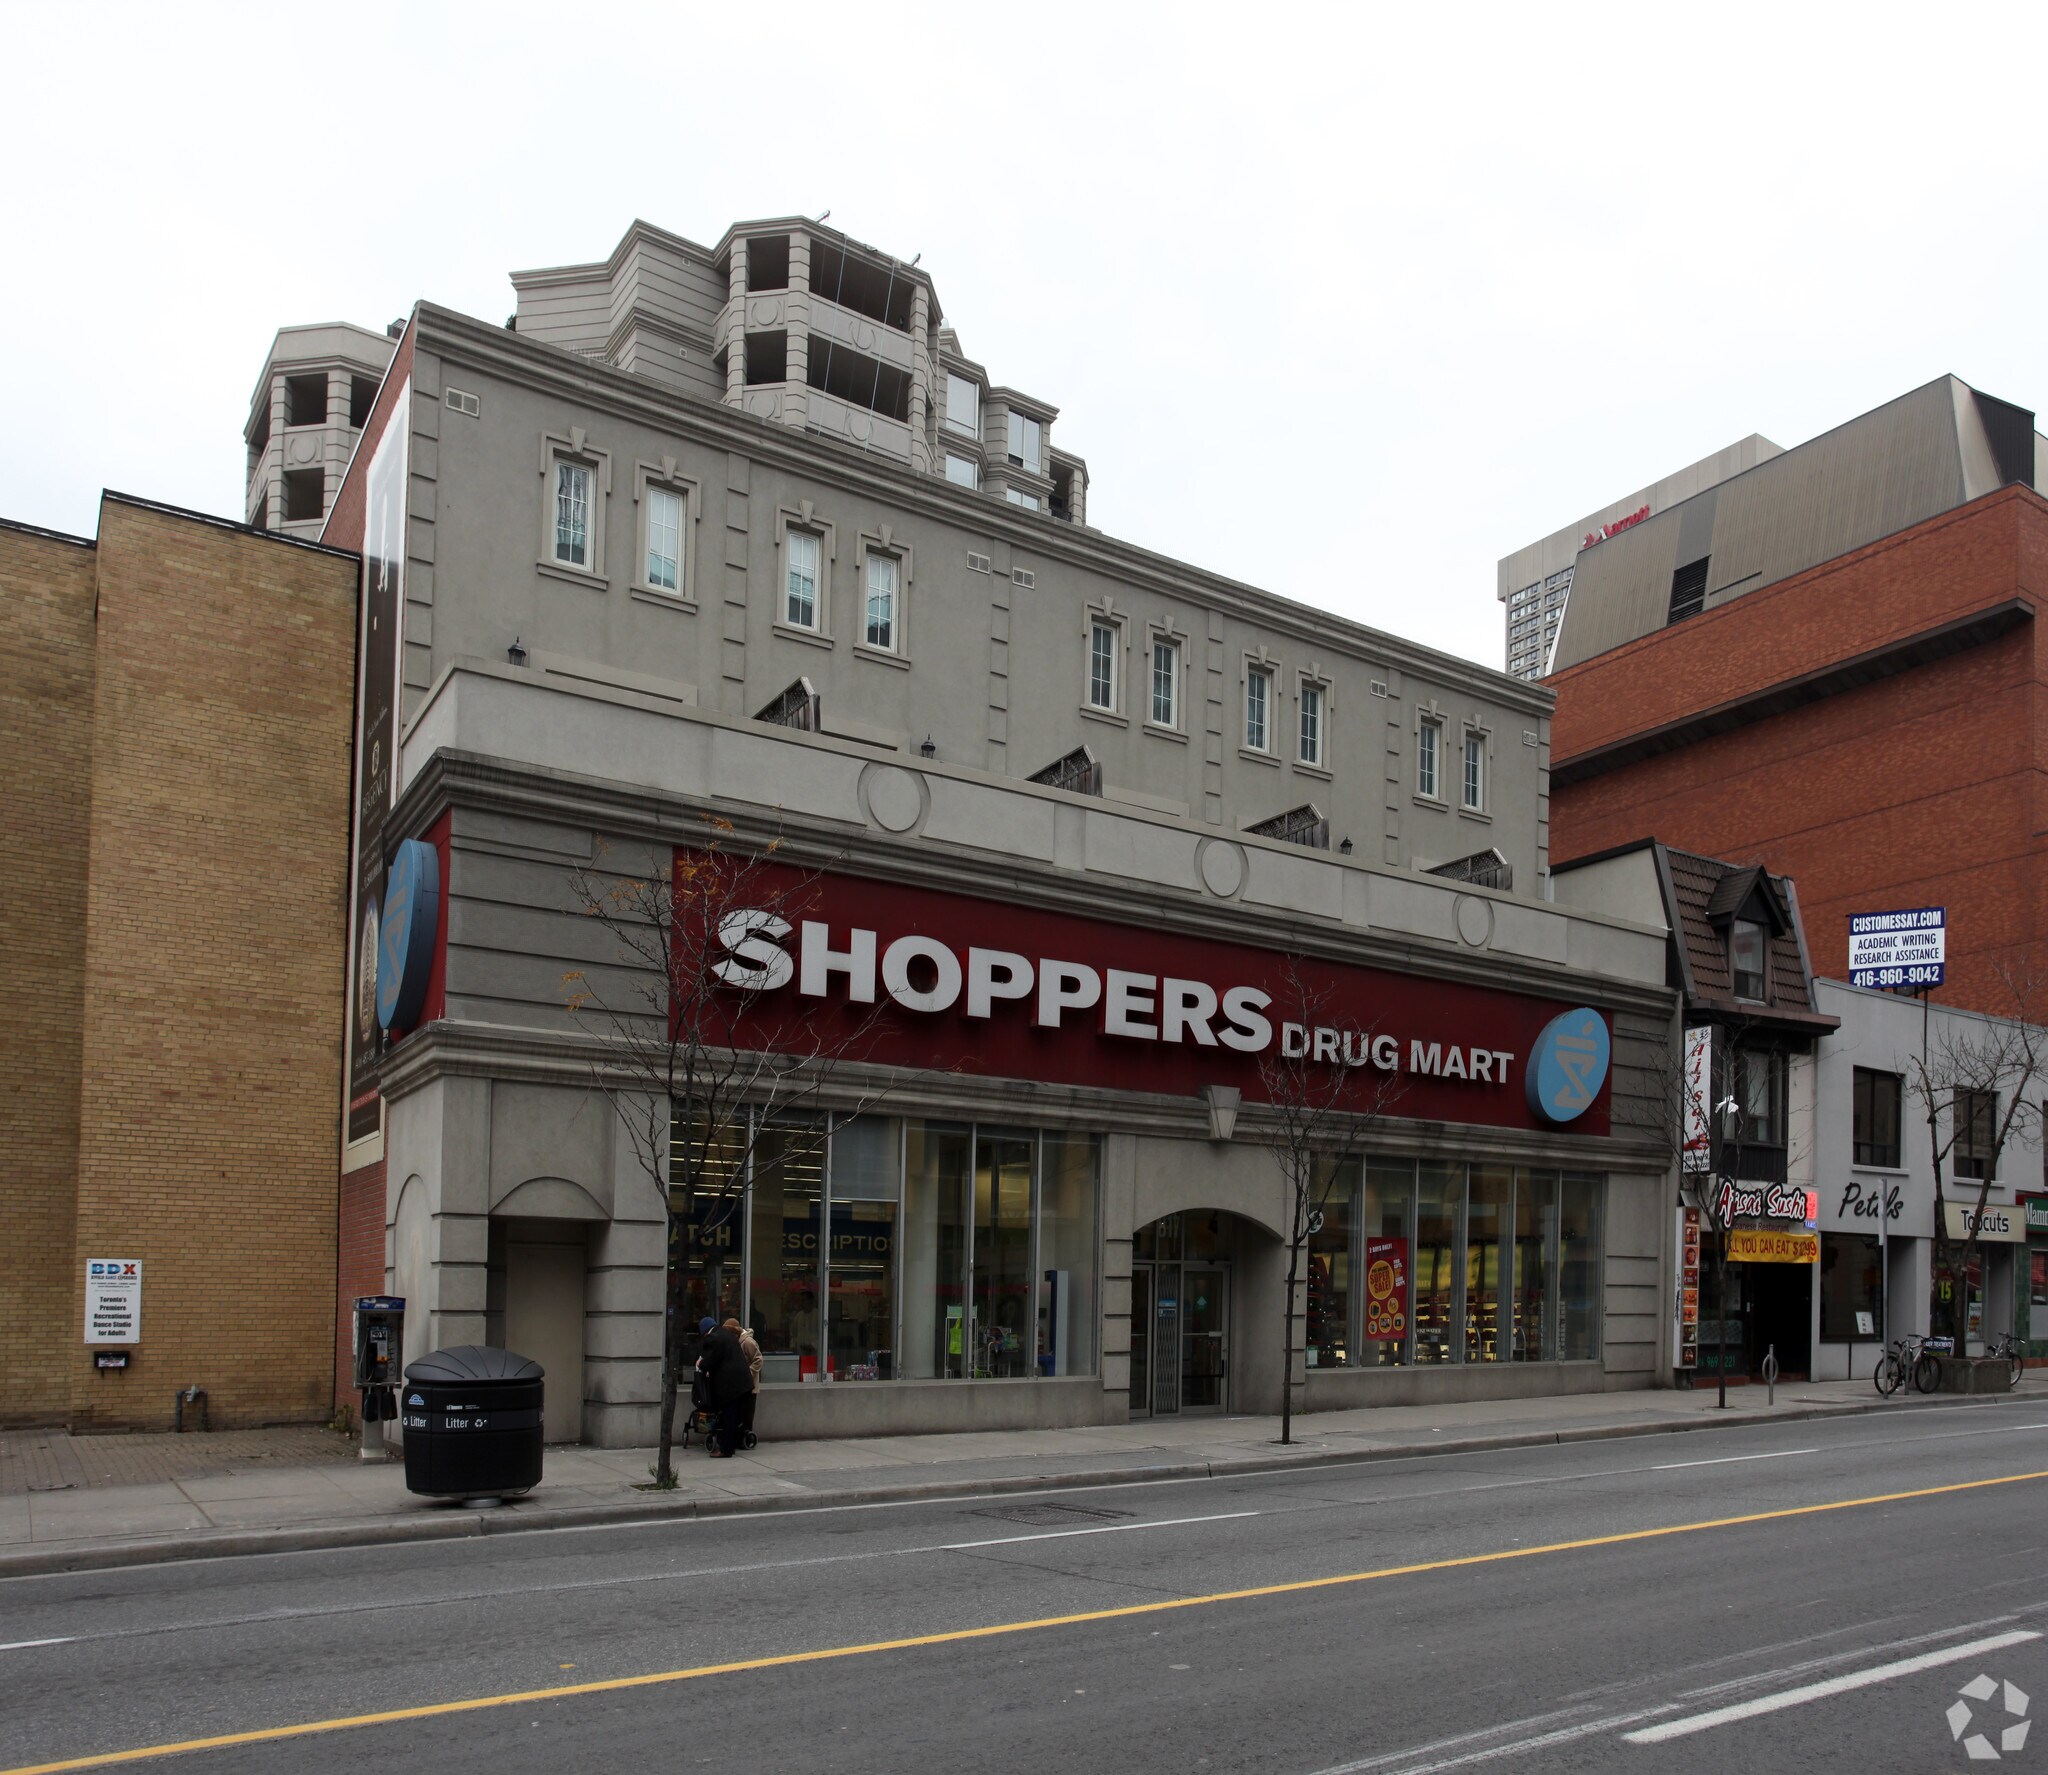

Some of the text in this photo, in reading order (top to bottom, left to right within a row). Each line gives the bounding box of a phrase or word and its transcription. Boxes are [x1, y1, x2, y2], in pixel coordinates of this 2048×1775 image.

[1852, 910, 1942, 933] CUSTOMESSAY.COM
[1857, 933, 1936, 950] ACADEMIC WRITING
[1854, 947, 1939, 965] RESEARCH ASSISTANCE
[709, 908, 1273, 1052] SHOPPERS
[1853, 965, 1940, 987] 416-960-9042
[1280, 1021, 1515, 1084] DRUG MART
[1718, 1181, 1762, 1228] Ajisai
[1767, 1185, 1806, 1220] Sushi
[1741, 1238, 1757, 1253] YOU
[1759, 1238, 1774, 1253] CAN
[1775, 1239, 1791, 1255] EAT
[91, 1263, 137, 1275] BDX
[1369, 1269, 1390, 1285] SUPER
[1374, 1280, 1391, 1294] SALE!
[410, 1416, 469, 1429] Litter Litter
